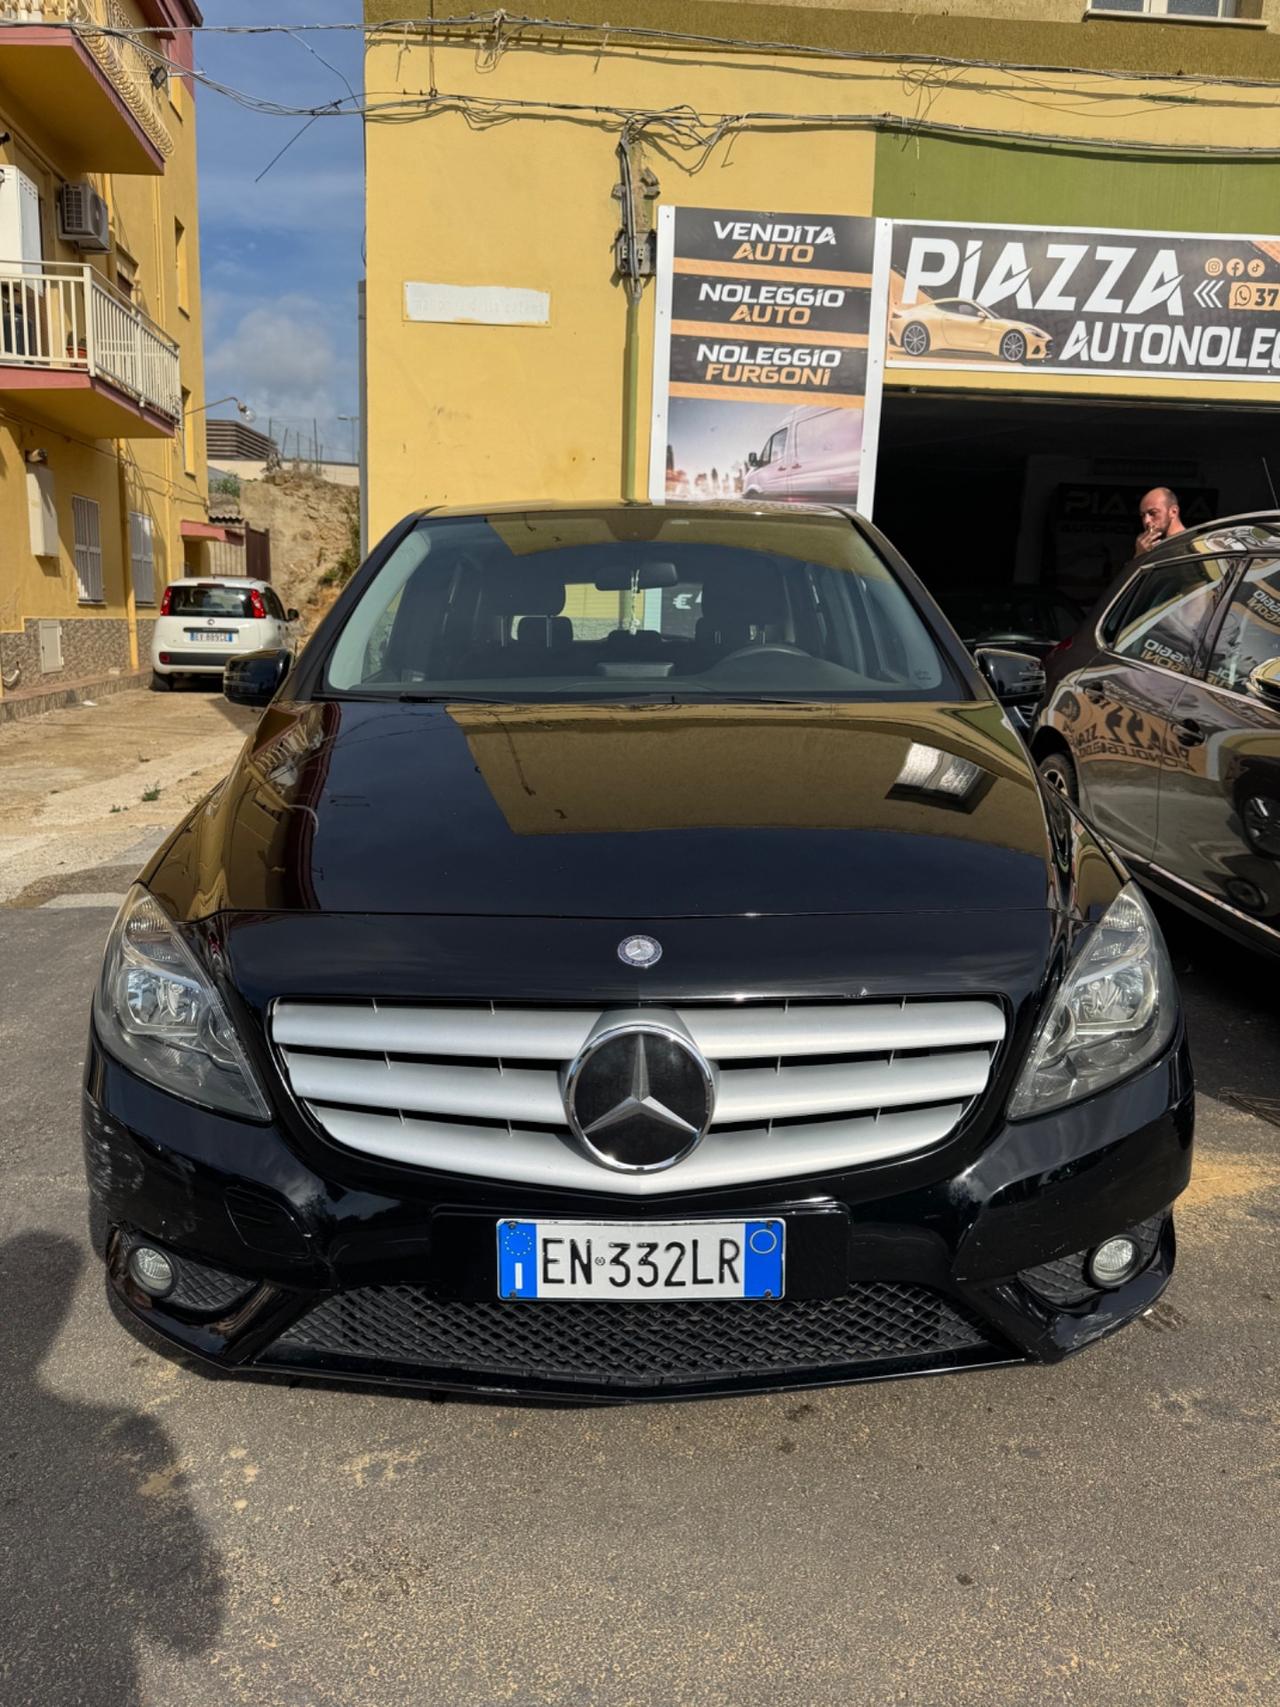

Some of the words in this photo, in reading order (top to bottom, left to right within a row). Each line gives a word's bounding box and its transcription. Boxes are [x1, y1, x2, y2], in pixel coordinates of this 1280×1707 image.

[713, 221, 837, 245] VENDITA
[732, 242, 815, 263] AUTO
[902, 237, 1185, 316] PIAZZA
[699, 283, 845, 307] NOLEGGIO
[1254, 287, 1279, 307] 37
[729, 305, 811, 325] AUTO
[696, 344, 842, 368] NOLEGGIO
[1058, 320, 1280, 369] AUTONOLE
[705, 364, 831, 386] FURGONI
